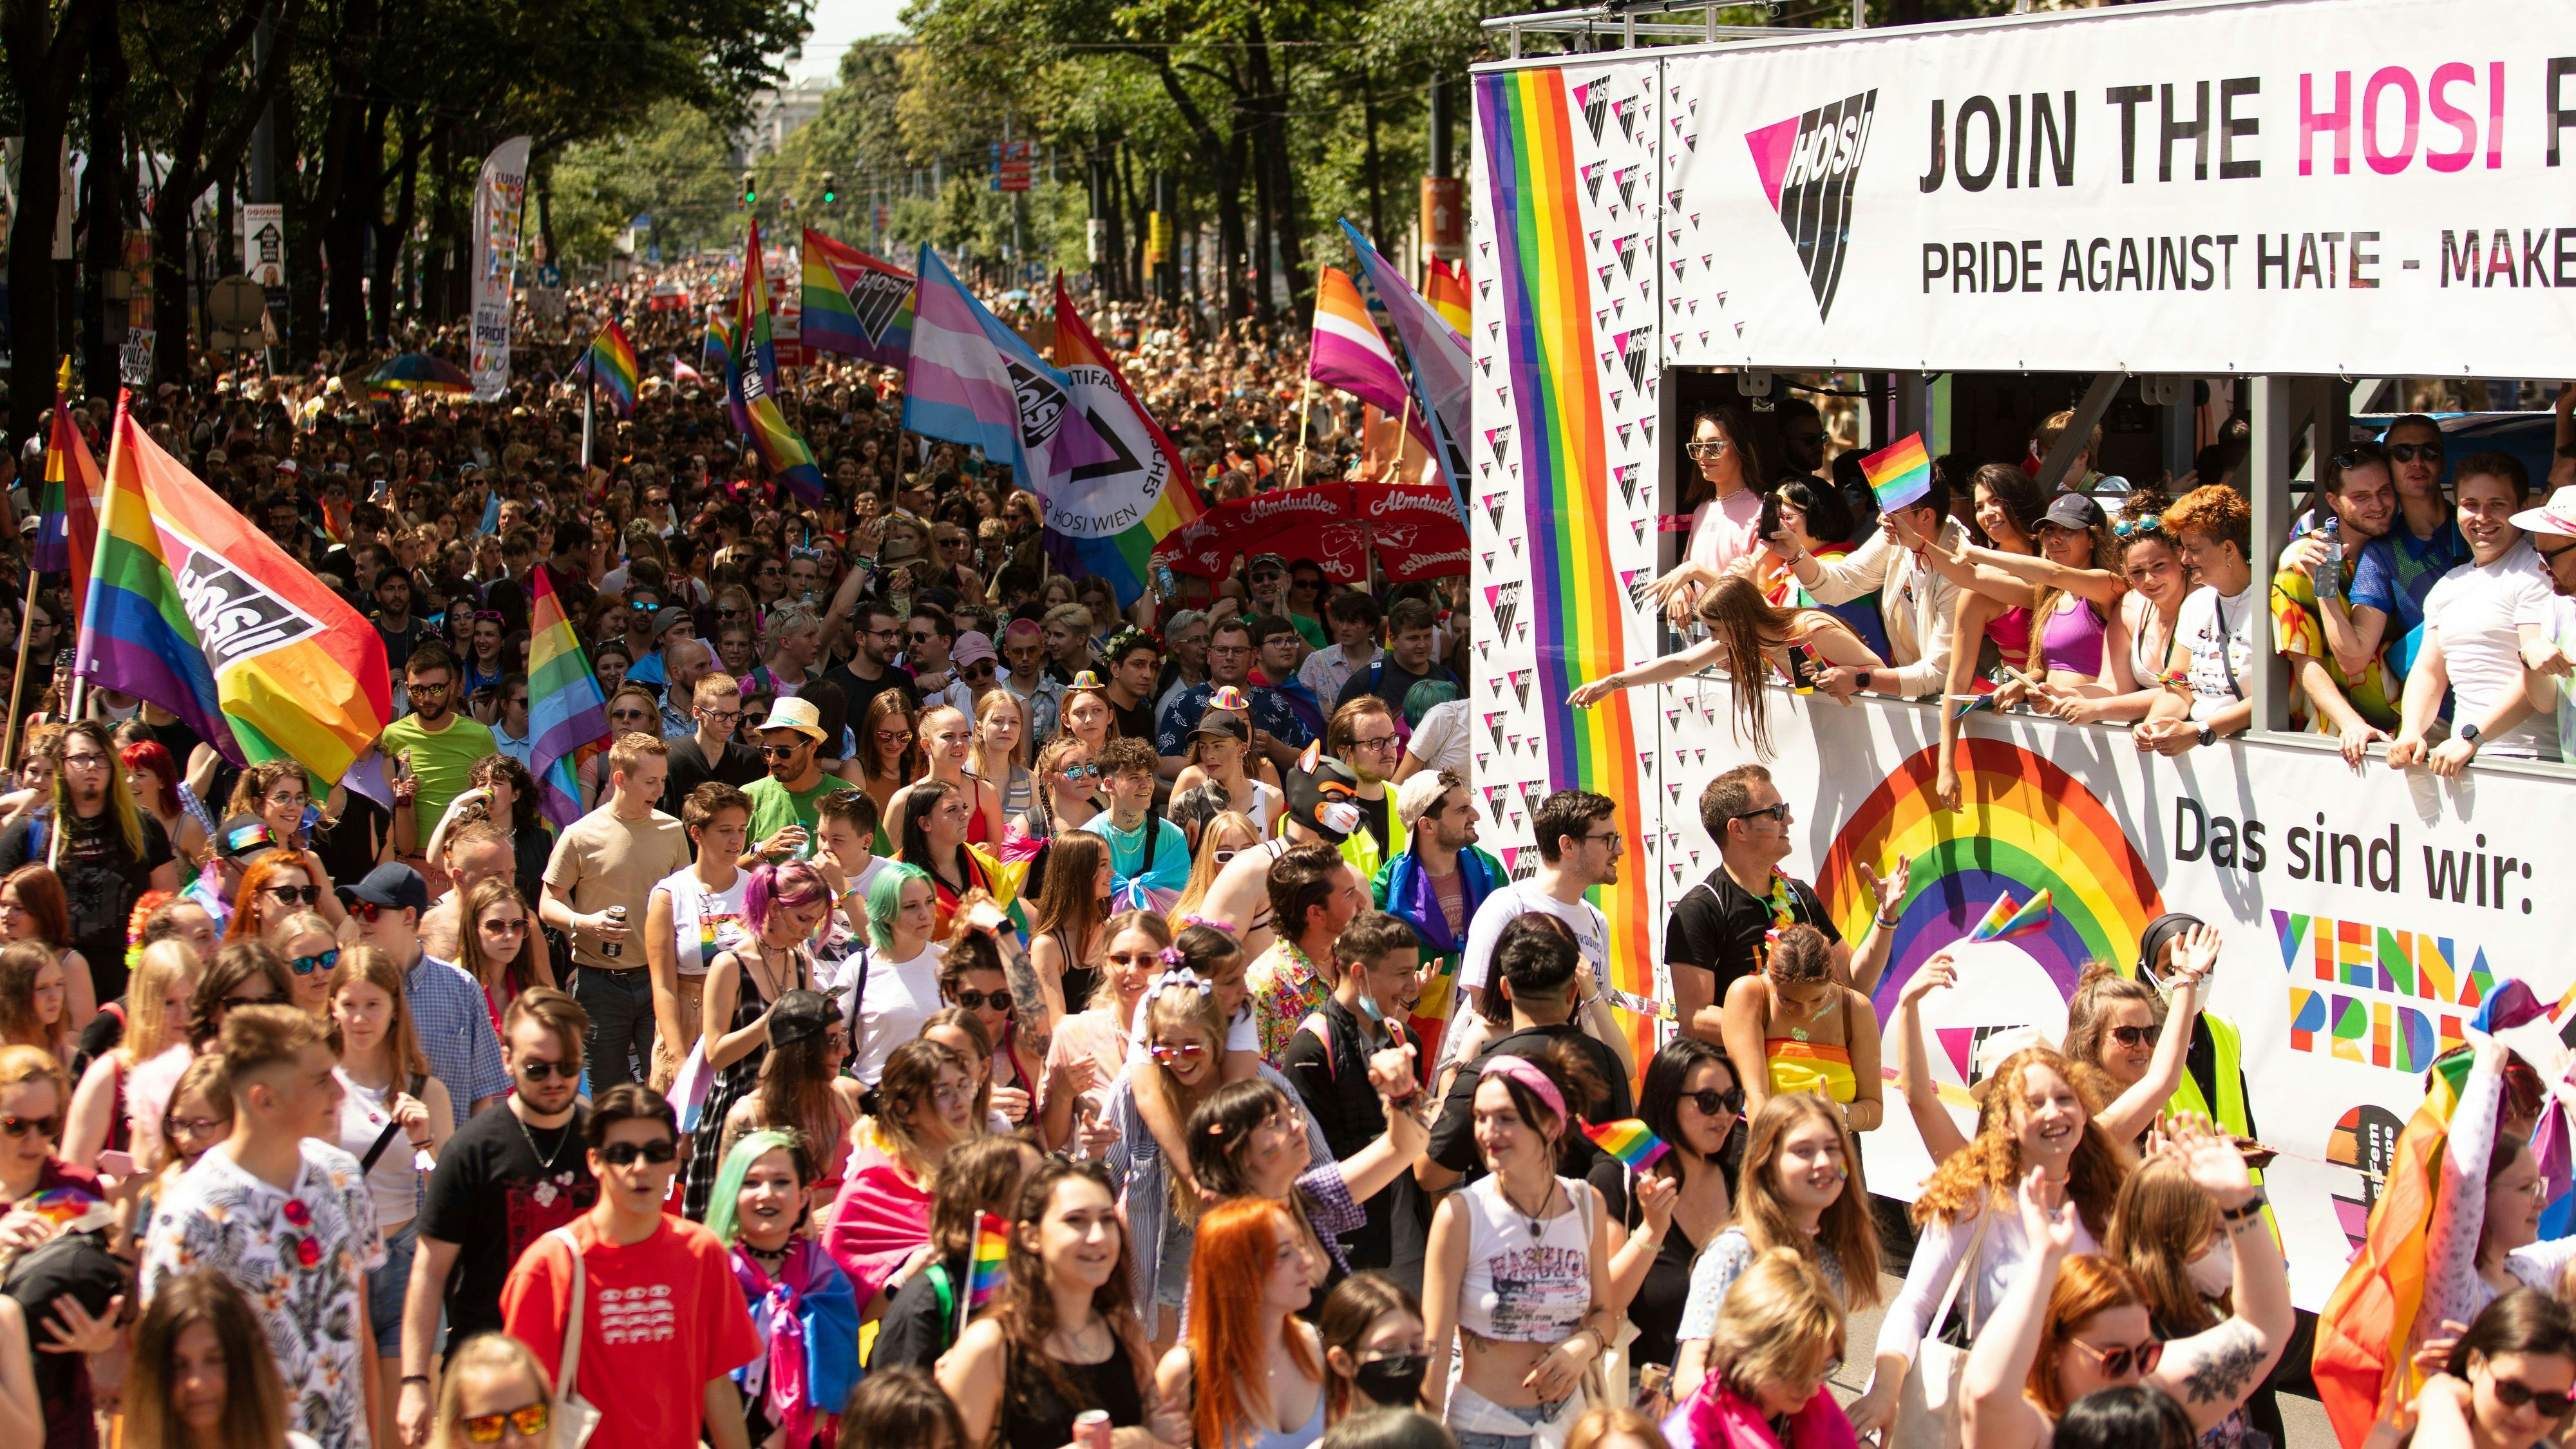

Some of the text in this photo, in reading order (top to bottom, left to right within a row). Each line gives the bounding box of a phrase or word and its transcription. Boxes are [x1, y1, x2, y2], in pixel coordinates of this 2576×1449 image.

[1586, 80, 1610, 106] HOSI
[1621, 99, 1638, 116] HOSI
[1920, 91, 2076, 193] JOIN
[2107, 77, 2260, 184] THE
[2298, 62, 2505, 176] HOSI
[1785, 110, 1873, 189] HOSI
[1590, 163, 1607, 180] HOSI
[1622, 167, 1639, 185] HOSI
[1622, 236, 1638, 253] HOSI
[1924, 240, 2042, 294] PRIDE
[2058, 234, 2238, 292] AGAINST
[2258, 232, 2380, 289] HATE
[2440, 228, 2576, 288] MAKE
[857, 274, 910, 294] HOSI
[477, 326, 506, 341] PRIDE
[1627, 330, 1652, 356] HOSI
[1494, 429, 1511, 444] HOSI
[1623, 466, 1640, 483] HOSI
[1241, 493, 1338, 524] Almdudler
[1491, 495, 1508, 510] HOSI
[1054, 503, 1139, 533] HOSI WIEN
[1632, 569, 1650, 586] HOSI
[1497, 585, 1522, 610] HOSI
[178, 568, 287, 657] HOSI
[1516, 672, 1531, 688] HOSI
[1492, 714, 1507, 730] HOSI
[1492, 788, 1508, 803] HOSI
[1525, 783, 1544, 797] HOSI
[1515, 850, 1540, 869] HOSI
[2175, 796, 2532, 914] Das sind wir:
[2270, 909, 2494, 1007] VIENNA
